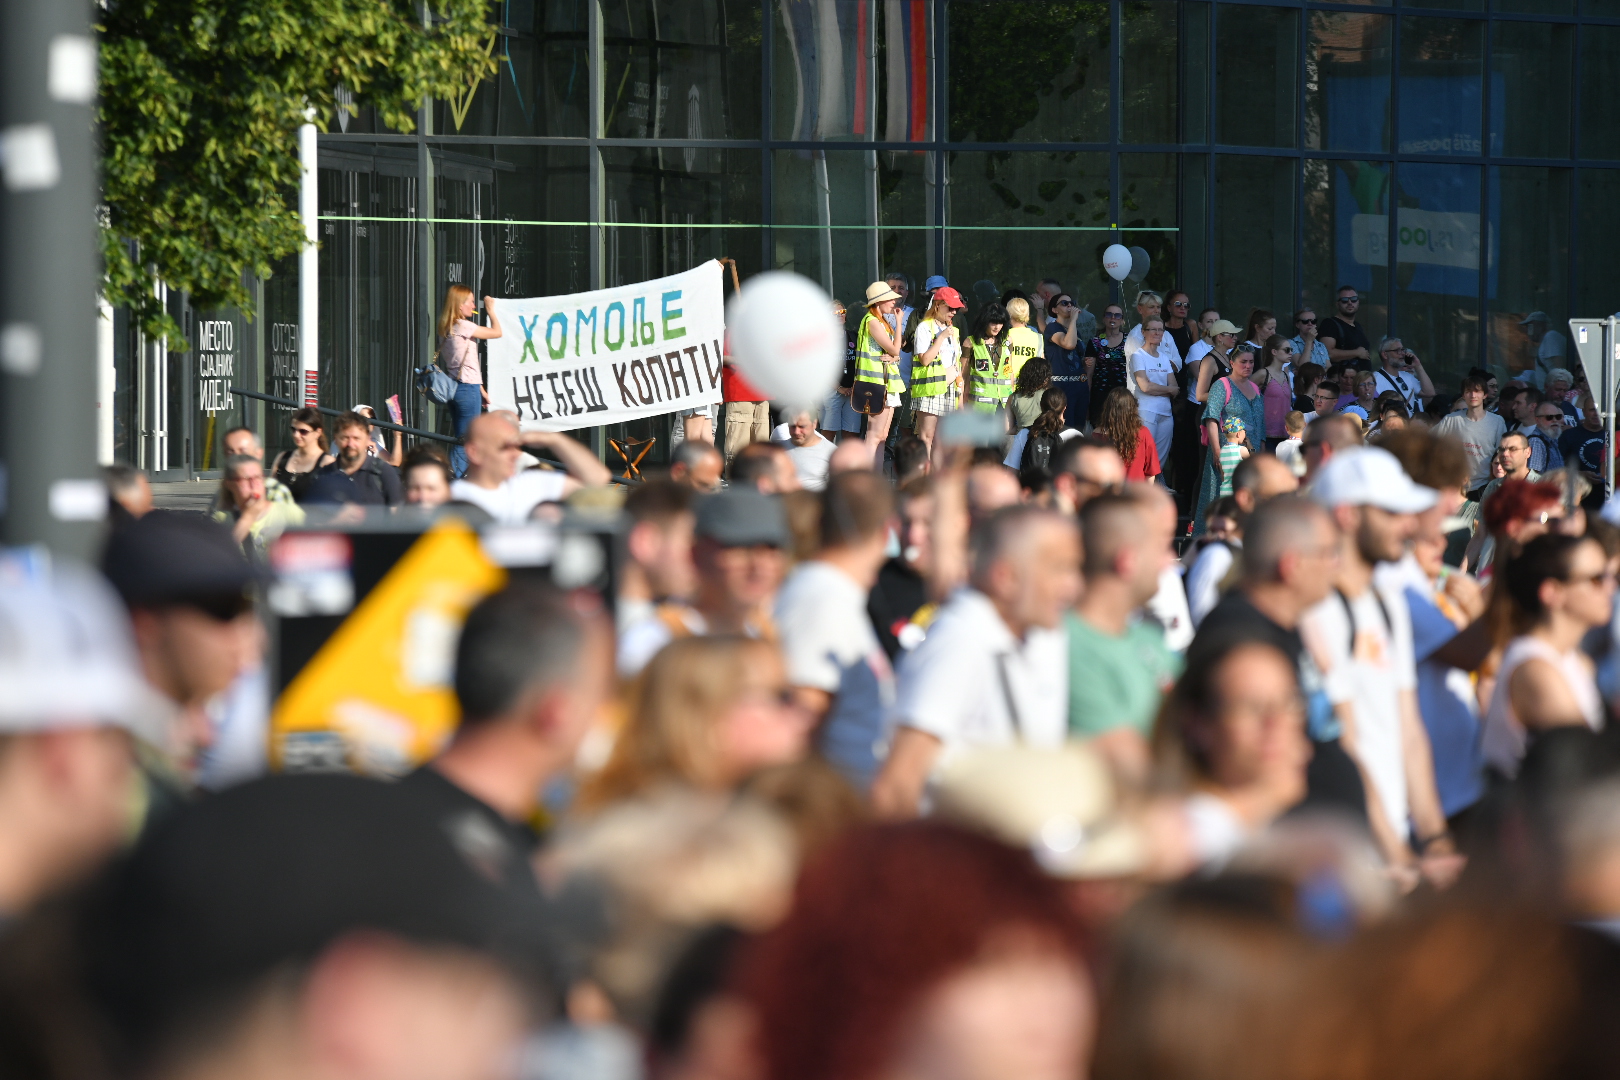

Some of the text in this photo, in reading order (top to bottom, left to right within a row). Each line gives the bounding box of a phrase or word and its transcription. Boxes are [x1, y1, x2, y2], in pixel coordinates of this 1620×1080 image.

[199, 320, 234, 351] МЕСТО
[518, 289, 687, 364] ХОМОЉЕ
[199, 353, 234, 377] СЈАЈНИХ
[1012, 345, 1036, 358] RESS
[512, 339, 723, 421] НЕЋЕШ КОПАТИ
[199, 379, 234, 418] ИДЕЈА
